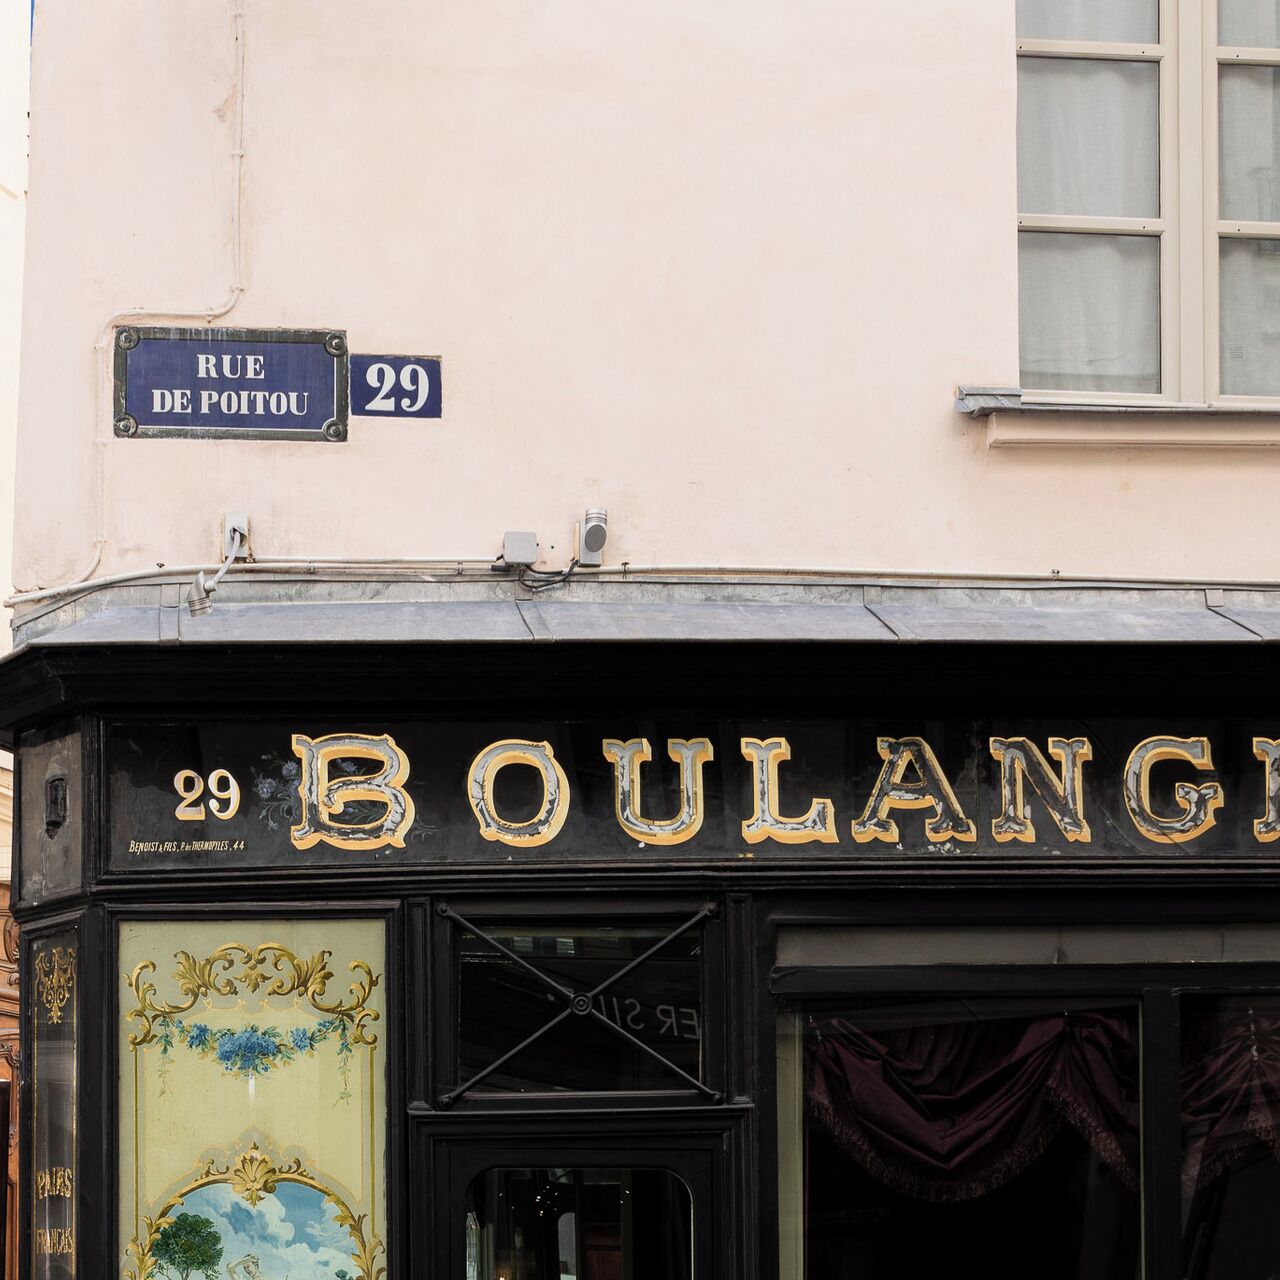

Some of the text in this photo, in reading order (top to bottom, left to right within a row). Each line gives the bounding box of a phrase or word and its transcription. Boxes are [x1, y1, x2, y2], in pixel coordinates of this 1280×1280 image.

[196, 354, 265, 379] RUE
[365, 363, 430, 413] 29
[151, 389, 310, 416] DE POITOU
[174, 768, 241, 821] 29
[129, 840, 158, 855] BENOIST
